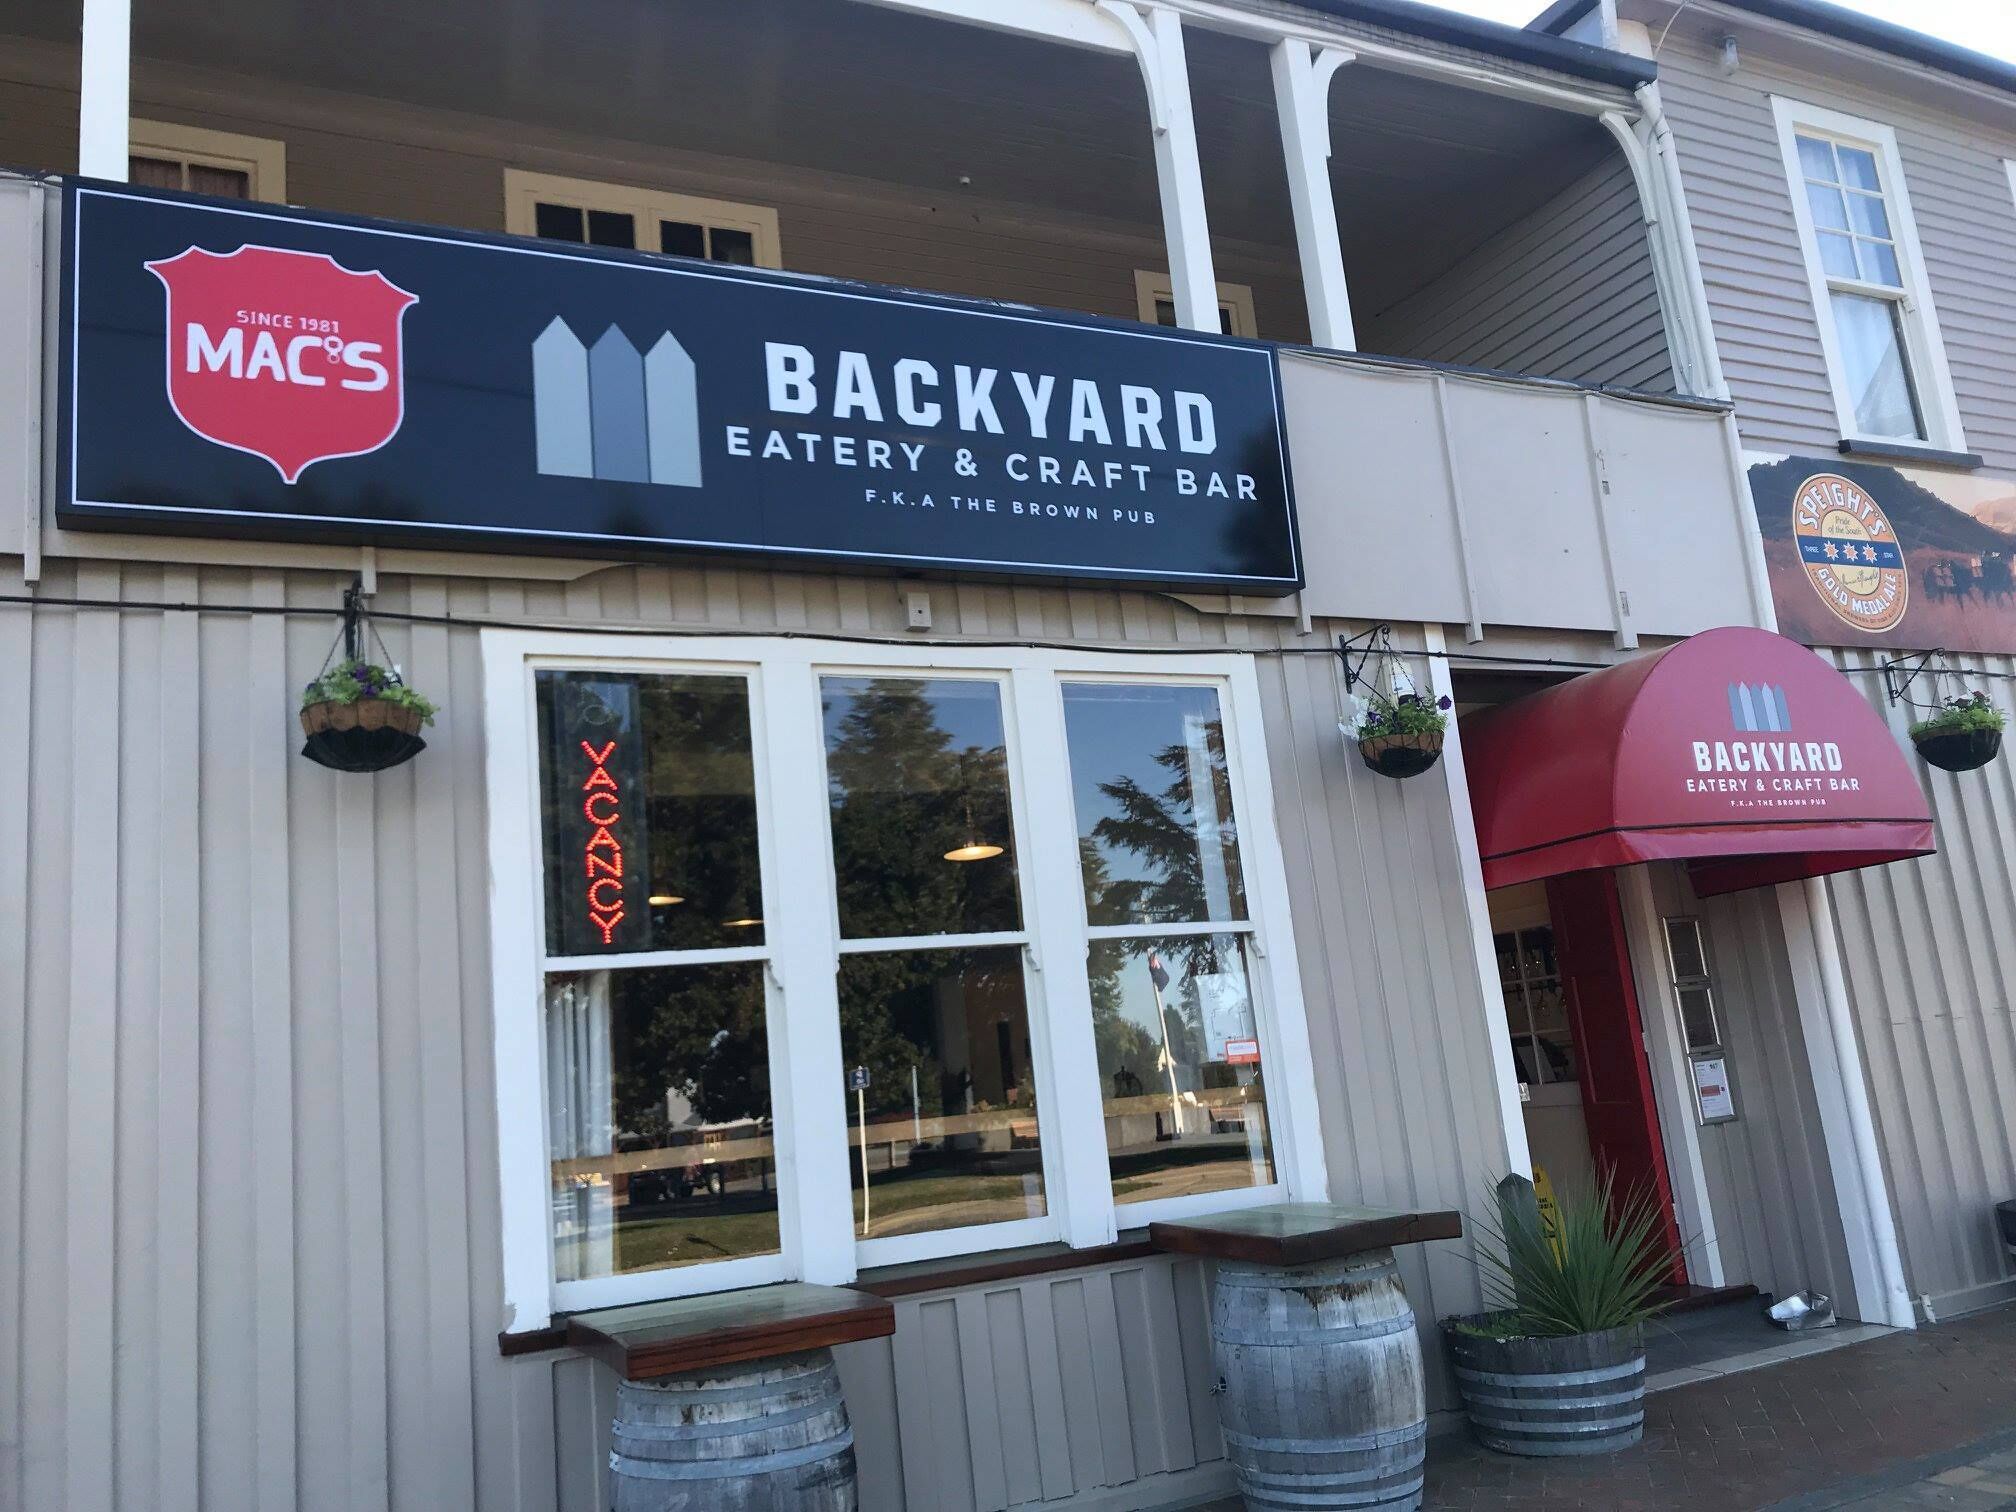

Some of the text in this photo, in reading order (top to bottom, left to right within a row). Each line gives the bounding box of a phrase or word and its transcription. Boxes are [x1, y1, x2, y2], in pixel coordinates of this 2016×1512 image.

[236, 310, 340, 334] SINCE 1981
[186, 322, 390, 392] MAC'S
[764, 341, 1217, 455] BACKYARD
[726, 425, 1258, 501] EATERY & CRAFT BAR
[865, 489, 1155, 524] F.K.A THE BROWN PUB
[1798, 482, 1886, 536] SPEIGHT'S
[1818, 568, 1849, 606] GOLD
[1852, 596, 1890, 615] MEDAL
[1887, 573, 1897, 602] ALE
[1692, 741, 1842, 772] BACKYARD
[1686, 778, 1860, 792] EATERY & CRAFT BAR
[1758, 799, 1773, 807] THE
[1810, 798, 1827, 806] PUB
[580, 740, 625, 944] VACANCY
